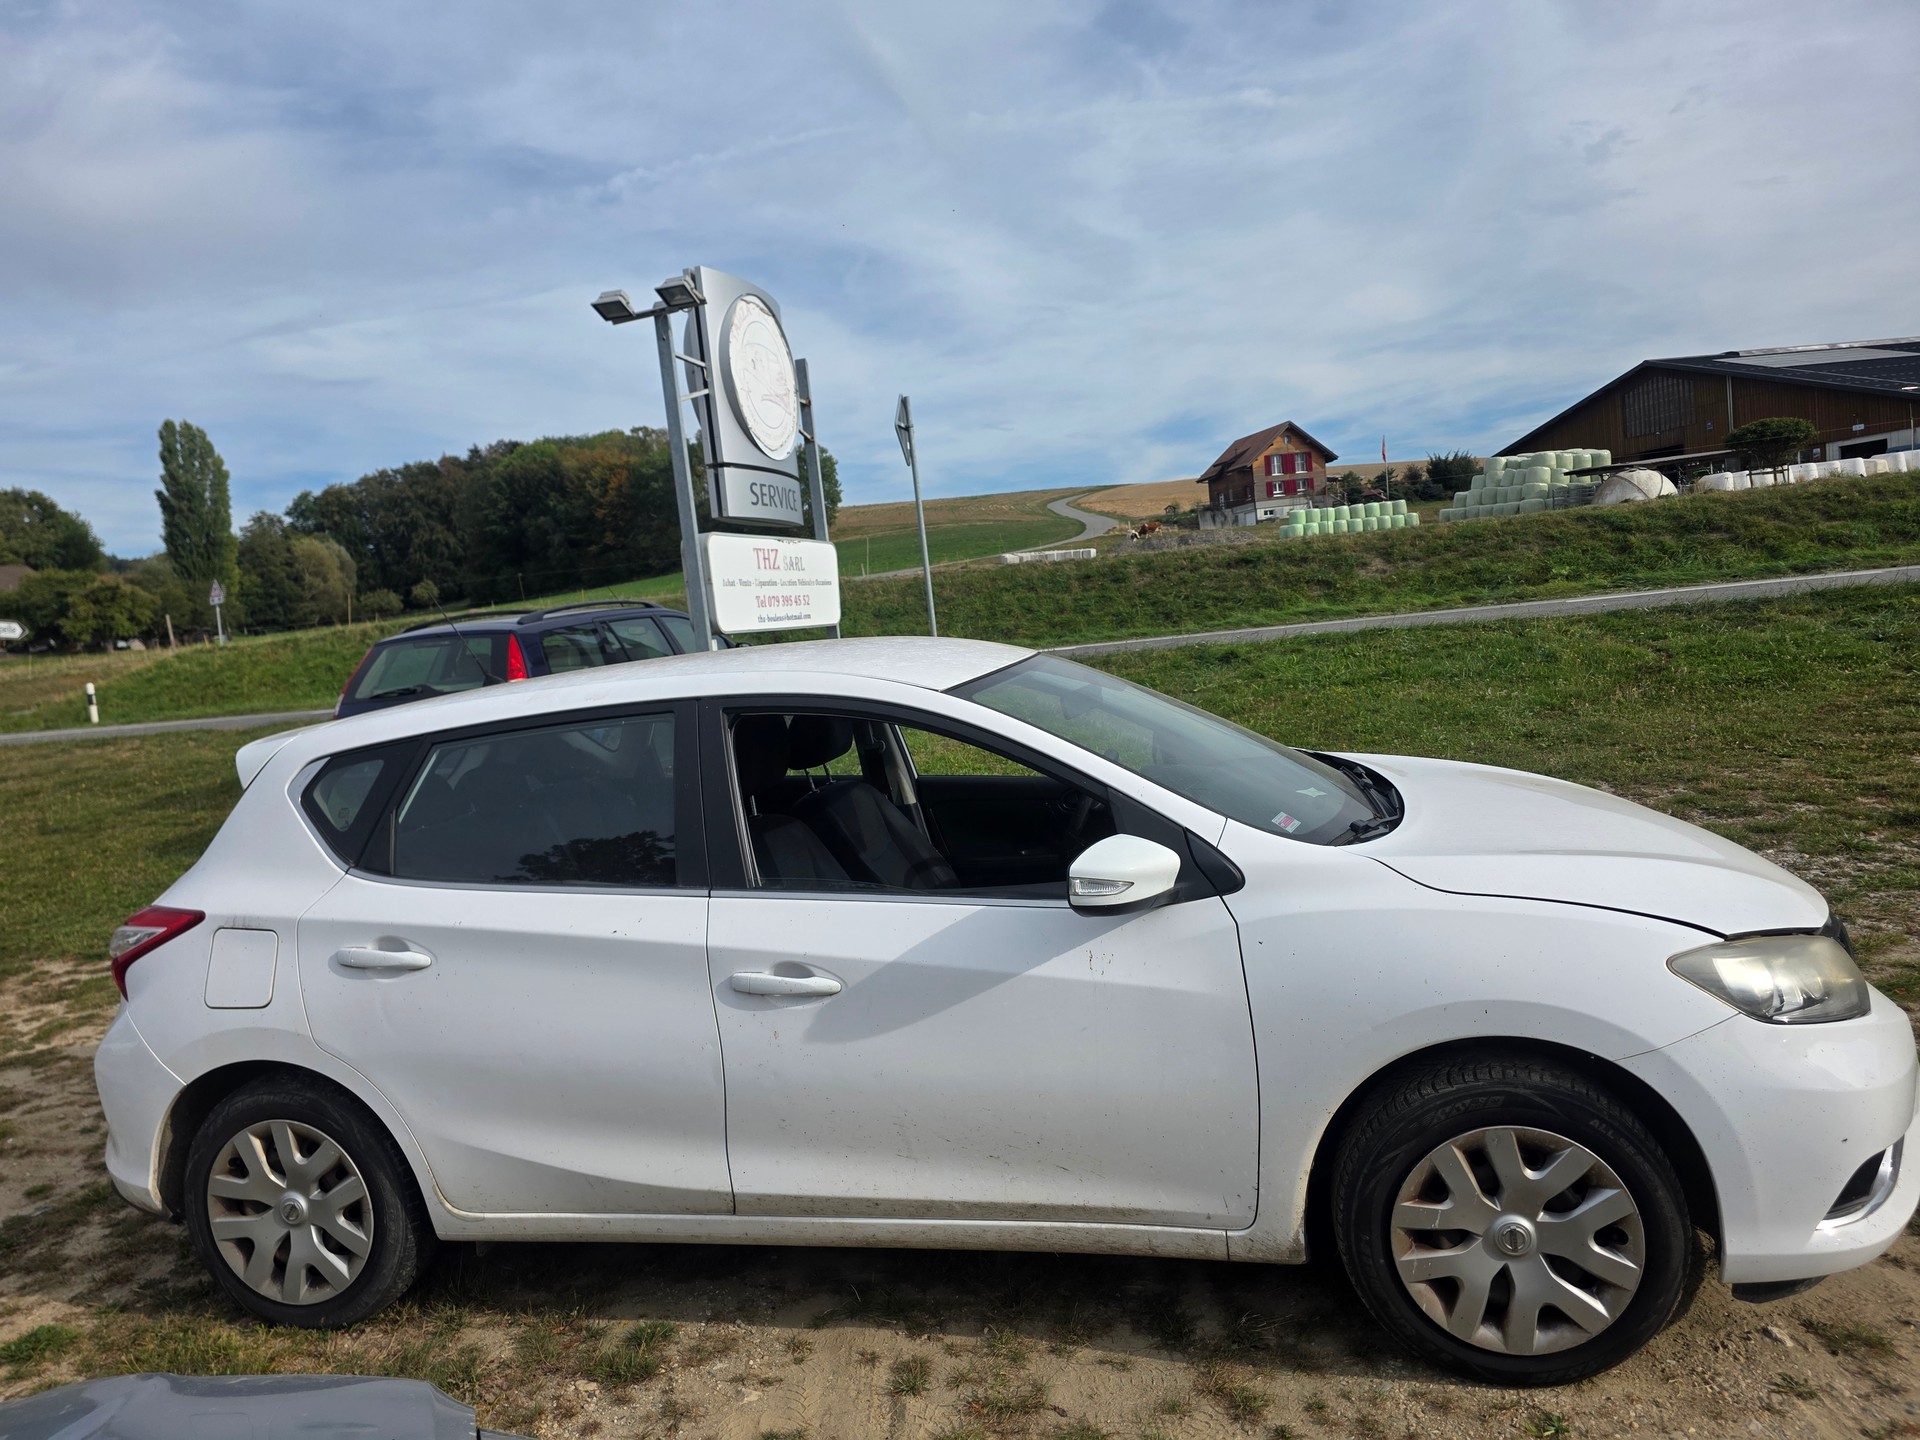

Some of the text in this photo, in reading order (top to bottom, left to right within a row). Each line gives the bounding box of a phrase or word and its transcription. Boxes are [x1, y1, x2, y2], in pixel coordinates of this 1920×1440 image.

[749, 482, 798, 512] SERVICE
[753, 548, 805, 571] THZ SARL
[755, 595, 767, 608] Tel
[767, 594, 780, 608] 079
[802, 594, 810, 606] 52
